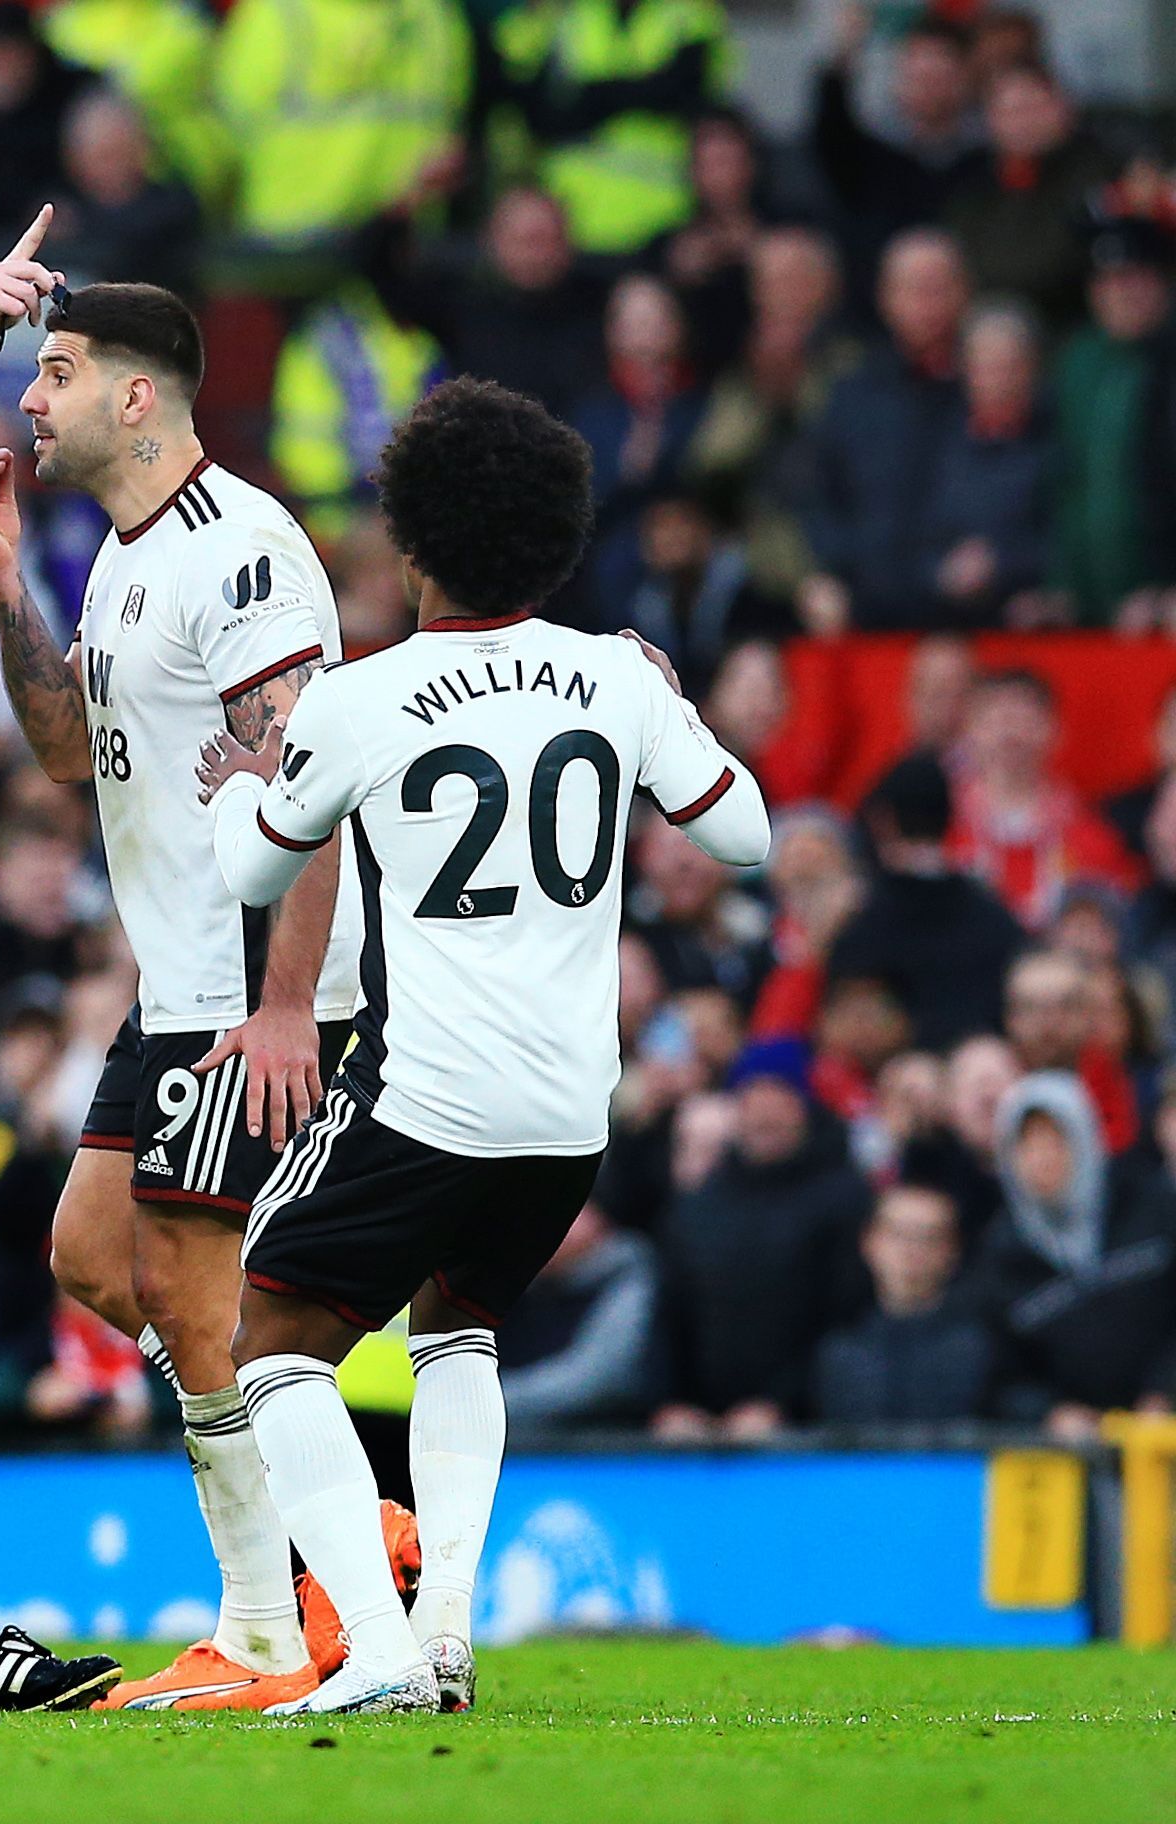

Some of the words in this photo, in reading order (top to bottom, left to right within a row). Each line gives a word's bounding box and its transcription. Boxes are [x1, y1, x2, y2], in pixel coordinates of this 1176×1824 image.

[221, 611, 258, 632] WORLD
[401, 659, 597, 726] WILLIAN
[401, 729, 620, 918] 20
[153, 1068, 199, 1141] 9
[138, 1161, 174, 1176] adidas
